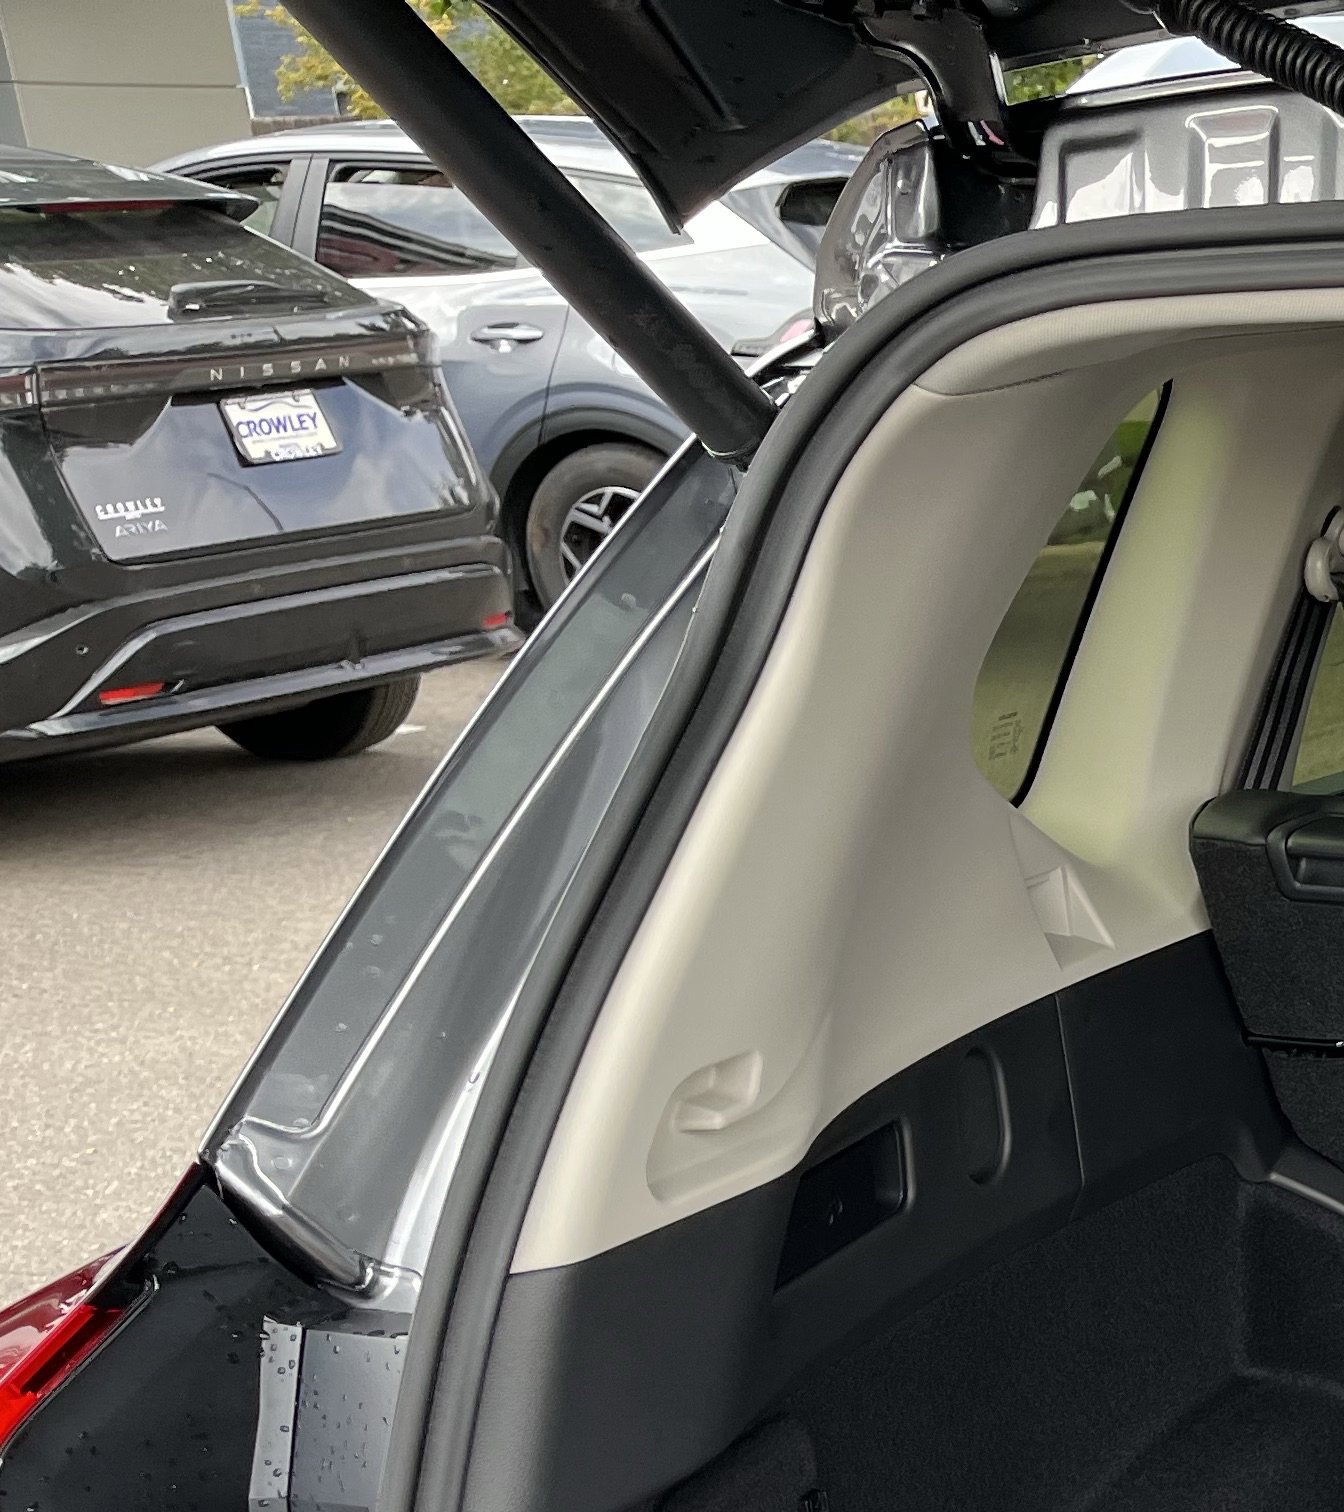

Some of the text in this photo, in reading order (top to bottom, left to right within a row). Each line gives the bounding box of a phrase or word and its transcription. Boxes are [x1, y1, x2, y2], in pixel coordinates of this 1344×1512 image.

[210, 357, 350, 381] NISSAN
[237, 412, 318, 438] CROWLEY
[115, 520, 168, 537] ARIYA
